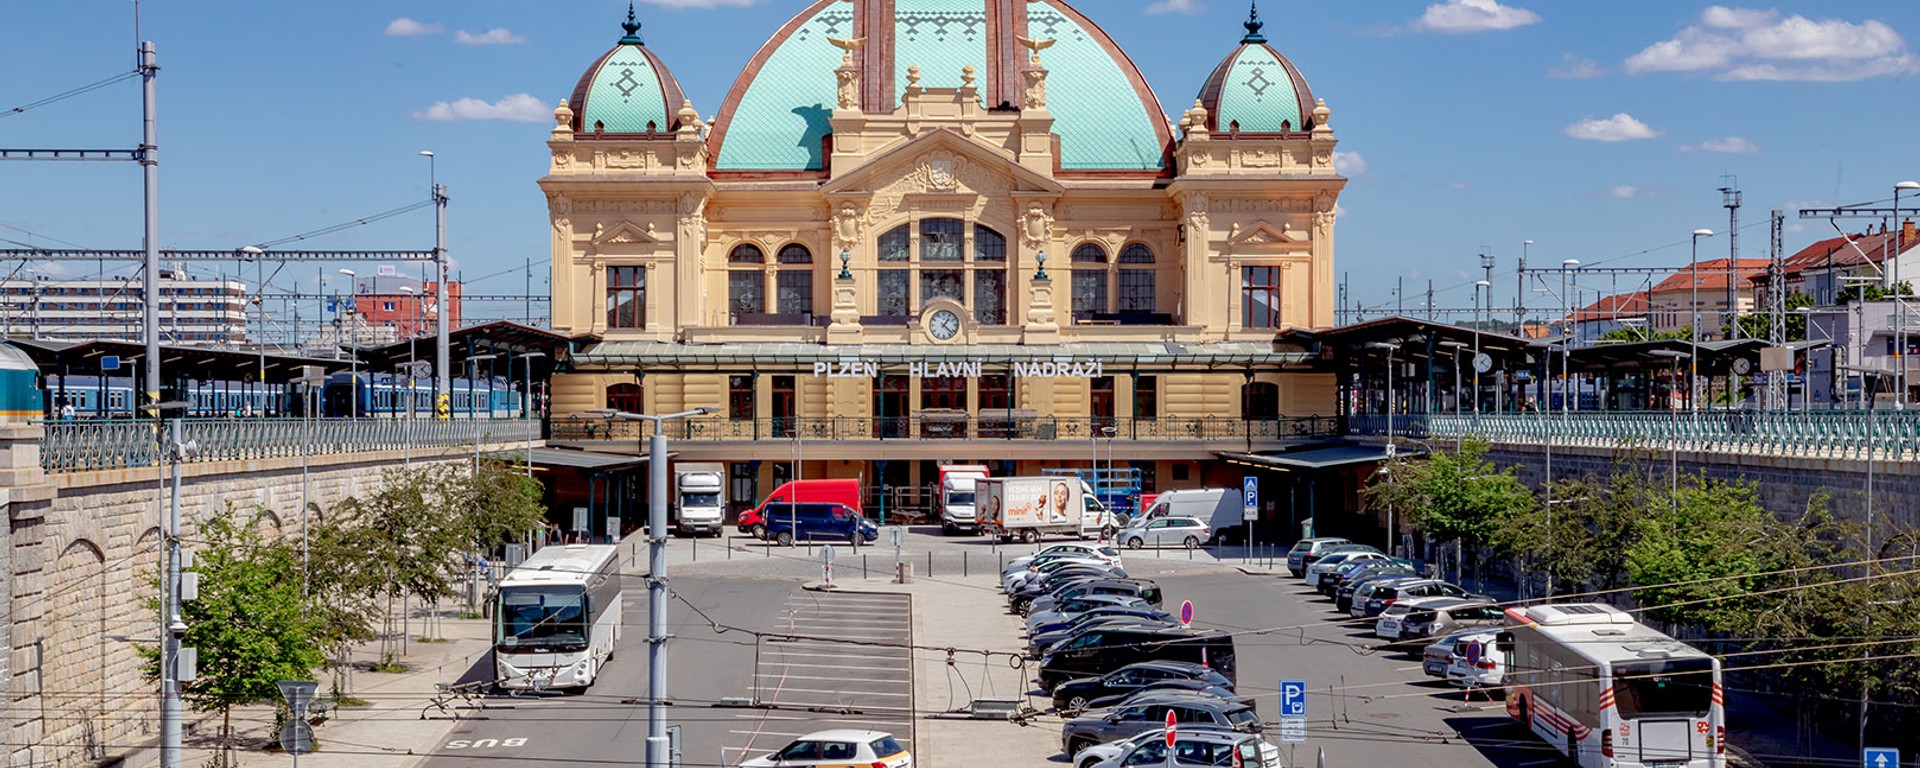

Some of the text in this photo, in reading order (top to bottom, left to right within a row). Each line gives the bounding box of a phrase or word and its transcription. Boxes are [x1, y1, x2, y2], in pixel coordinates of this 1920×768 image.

[813, 357, 1103, 377] PLZEŇ HLAVNÍ NÁDRAŽÍ
[1247, 491, 1256, 502] P
[1285, 685, 1301, 705] P
[445, 737, 529, 749] BUS
